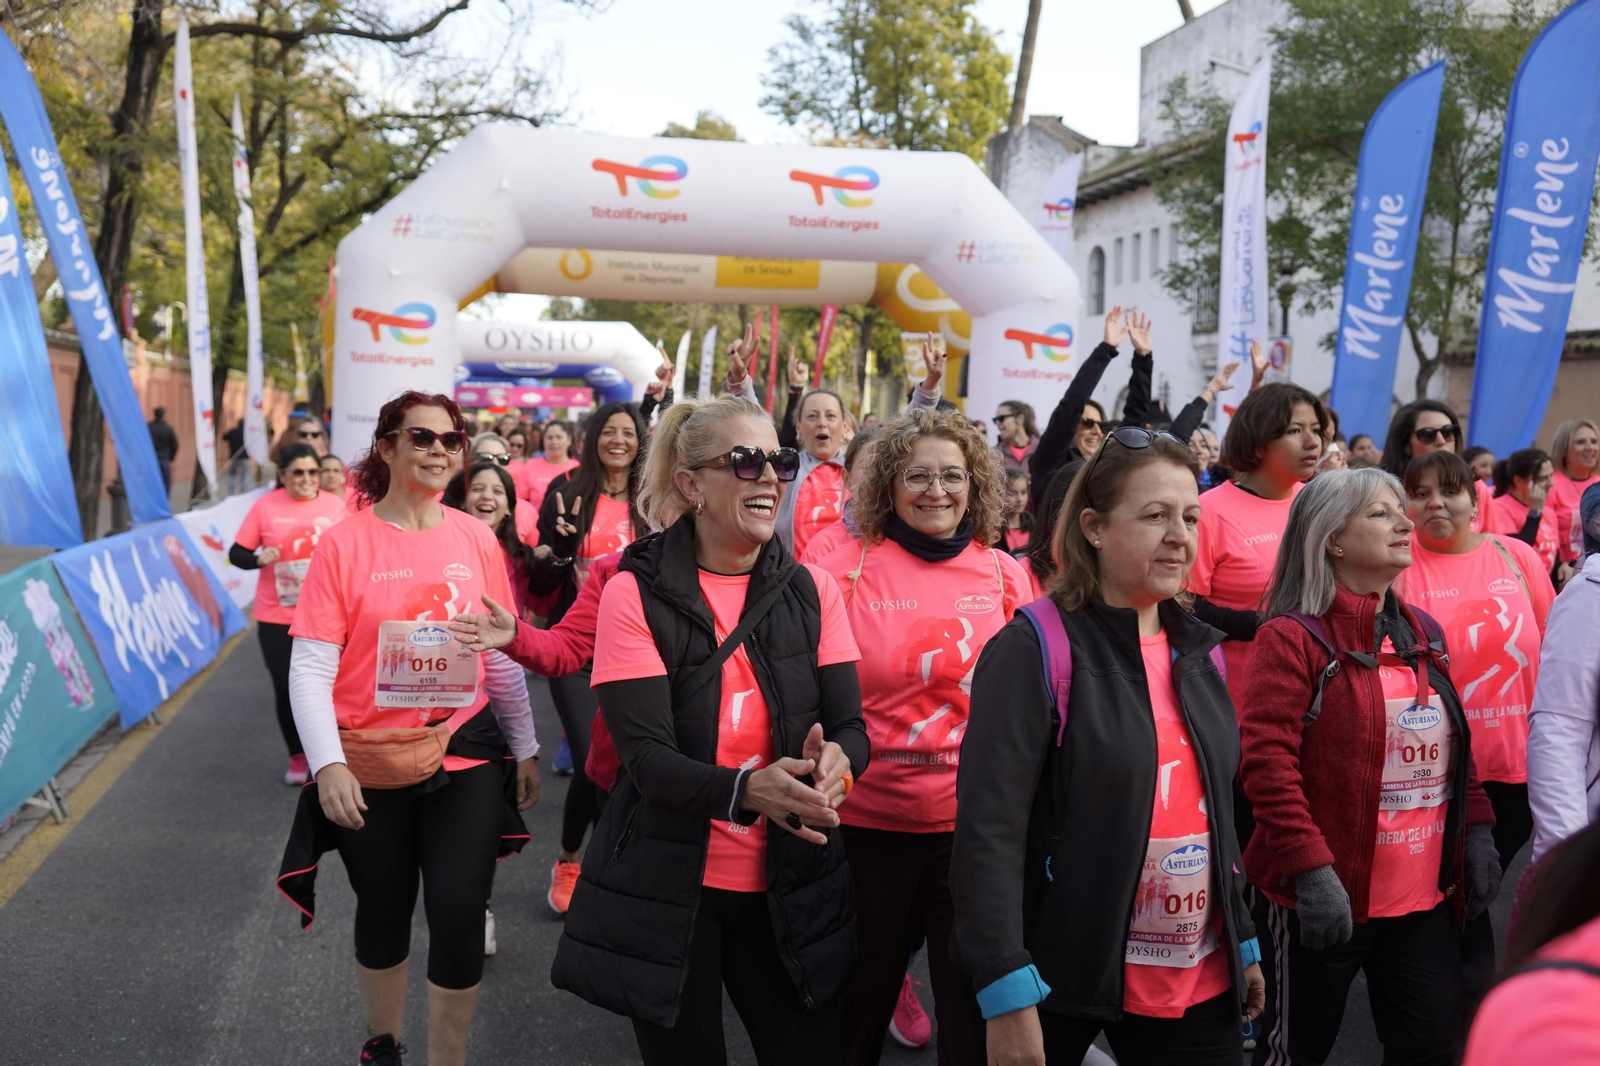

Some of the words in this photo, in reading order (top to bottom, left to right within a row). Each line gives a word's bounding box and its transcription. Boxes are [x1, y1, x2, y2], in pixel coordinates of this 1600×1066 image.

[589, 205, 688, 224] TotalEnergies
[787, 214, 879, 232] TotalEnergies
[1494, 137, 1579, 333] Marlene
[607, 259, 649, 272] Instituto
[651, 261, 700, 275] Municipal
[622, 273, 637, 284] de
[639, 273, 685, 287] Deportes
[1343, 194, 1409, 360] Marlene
[485, 328, 593, 351] OYSHO
[349, 350, 434, 368] TotalEnergies
[1002, 366, 1072, 383] TotalEnergie
[1244, 532, 1278, 547] OYSHO
[371, 568, 413, 582] OYSHO
[1421, 587, 1459, 600] OYSHO
[870, 598, 918, 612] OYSHO
[958, 601, 993, 610] ASTURIANA
[411, 634, 448, 643] ASTURIANA
[411, 657, 448, 672] 016
[419, 677, 437, 685] 6155
[386, 694, 418, 703] OYSHO
[1483, 707, 1495, 719] DE
[1496, 706, 1506, 719] LA
[1400, 714, 1439, 726] ASTURIANA
[878, 751, 926, 766] CARRERA
[929, 752, 943, 765] DE
[945, 751, 958, 764] LA
[1402, 743, 1439, 764] 016
[1413, 768, 1431, 779] 2930
[1419, 778, 1436, 787] MUJER
[727, 822, 749, 835] 2025
[1376, 831, 1405, 845] RERA
[1408, 828, 1421, 842] DE
[1421, 826, 1431, 840] LA
[1409, 842, 1425, 855] 2025
[1165, 856, 1207, 871] ASTURIANA
[1164, 889, 1206, 915] 016
[1176, 921, 1198, 933] 2875
[1131, 932, 1163, 943] CARRERA
[1164, 935, 1173, 943] DE
[1126, 946, 1171, 958] OYSHO
